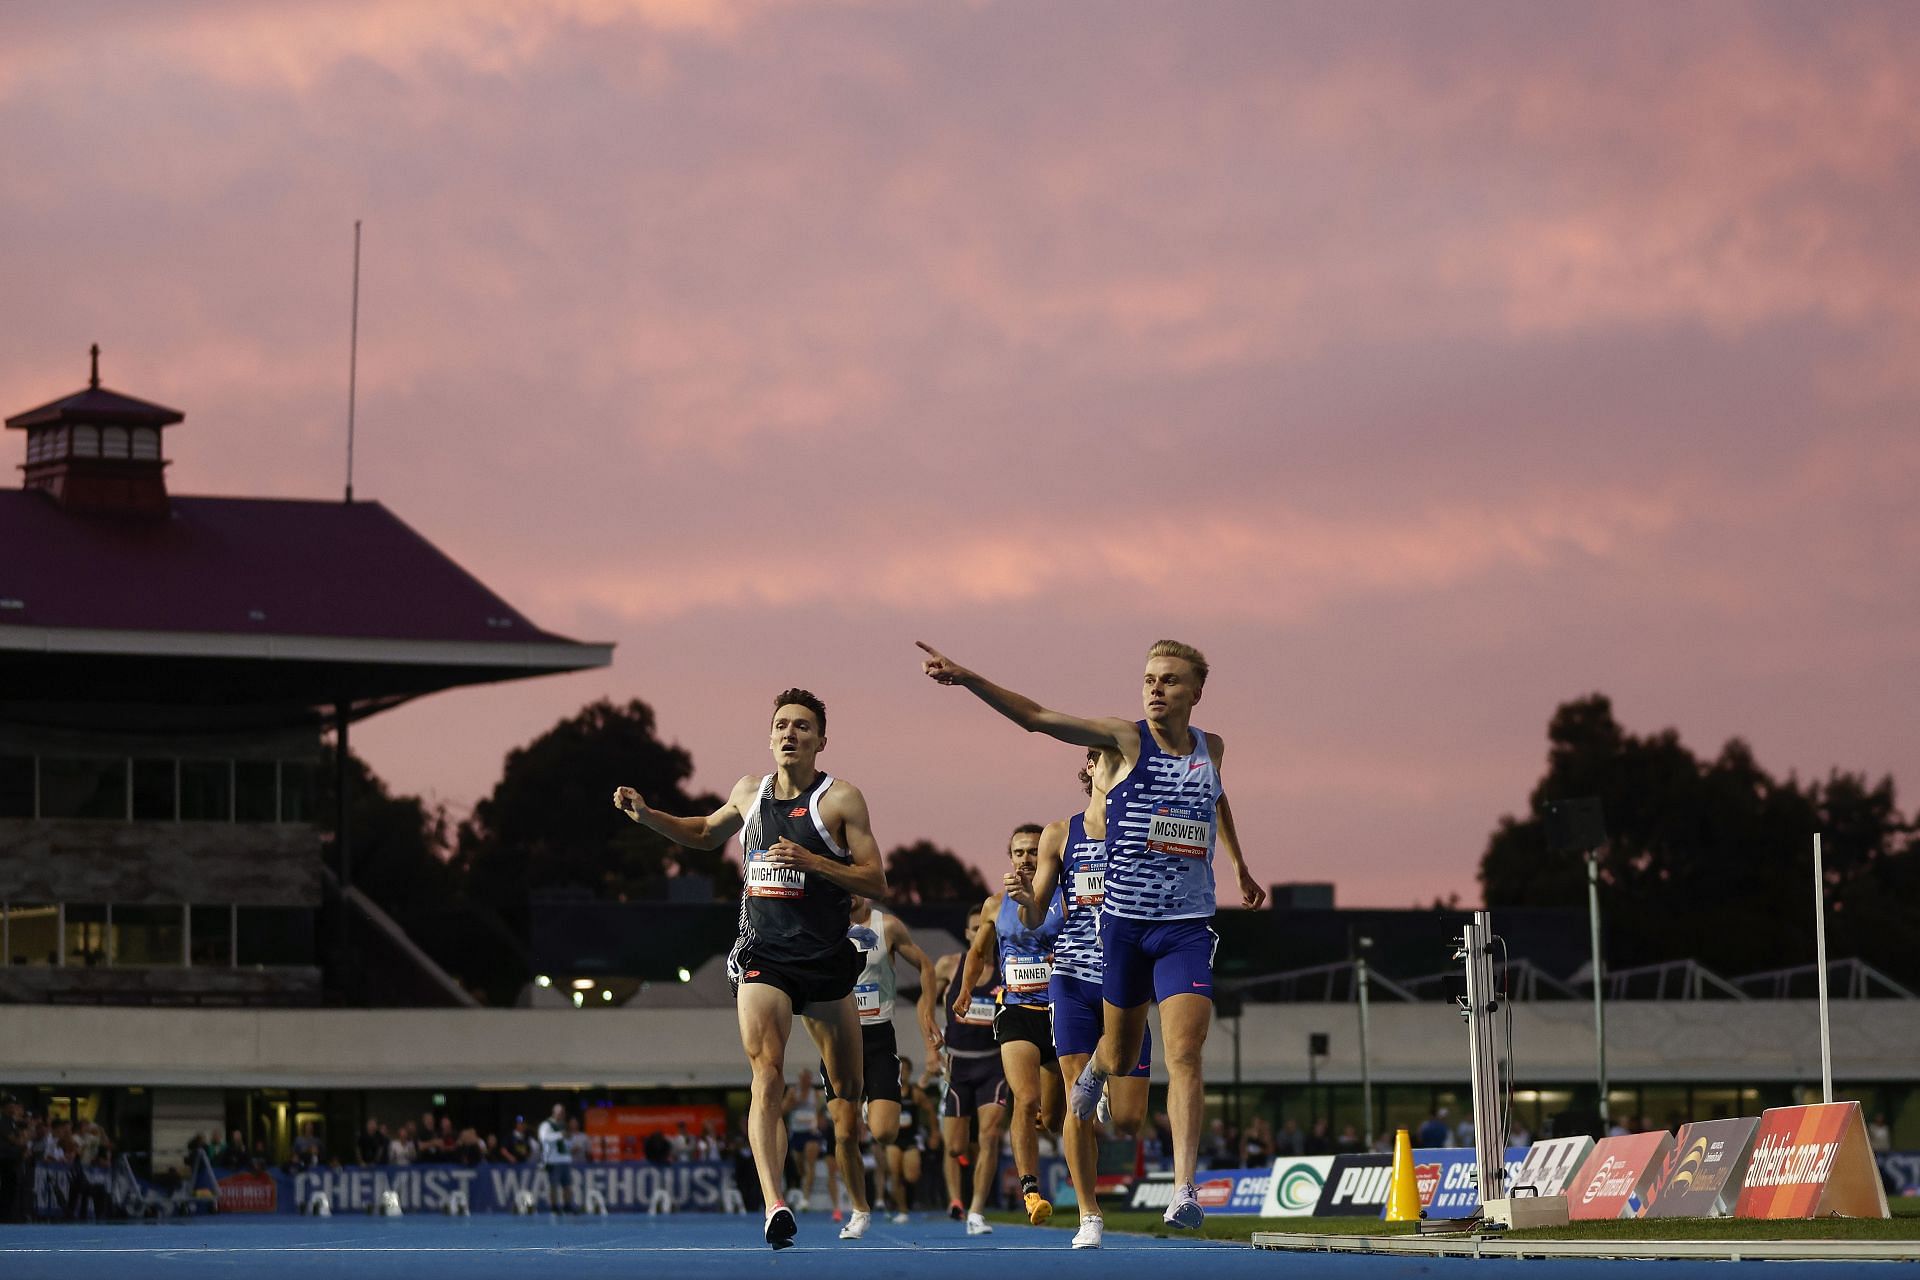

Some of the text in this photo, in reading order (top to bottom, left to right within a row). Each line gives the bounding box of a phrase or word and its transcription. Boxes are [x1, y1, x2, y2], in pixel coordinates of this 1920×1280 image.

[1154, 820, 1206, 842] MCSWEYN
[751, 867, 801, 883] WIGHTMAN
[1014, 967, 1047, 980] TANNER
[1744, 1132, 1839, 1188] athletics.com.au
[295, 1170, 476, 1211] CHEMIST
[1331, 1166, 1394, 1205] PUM
